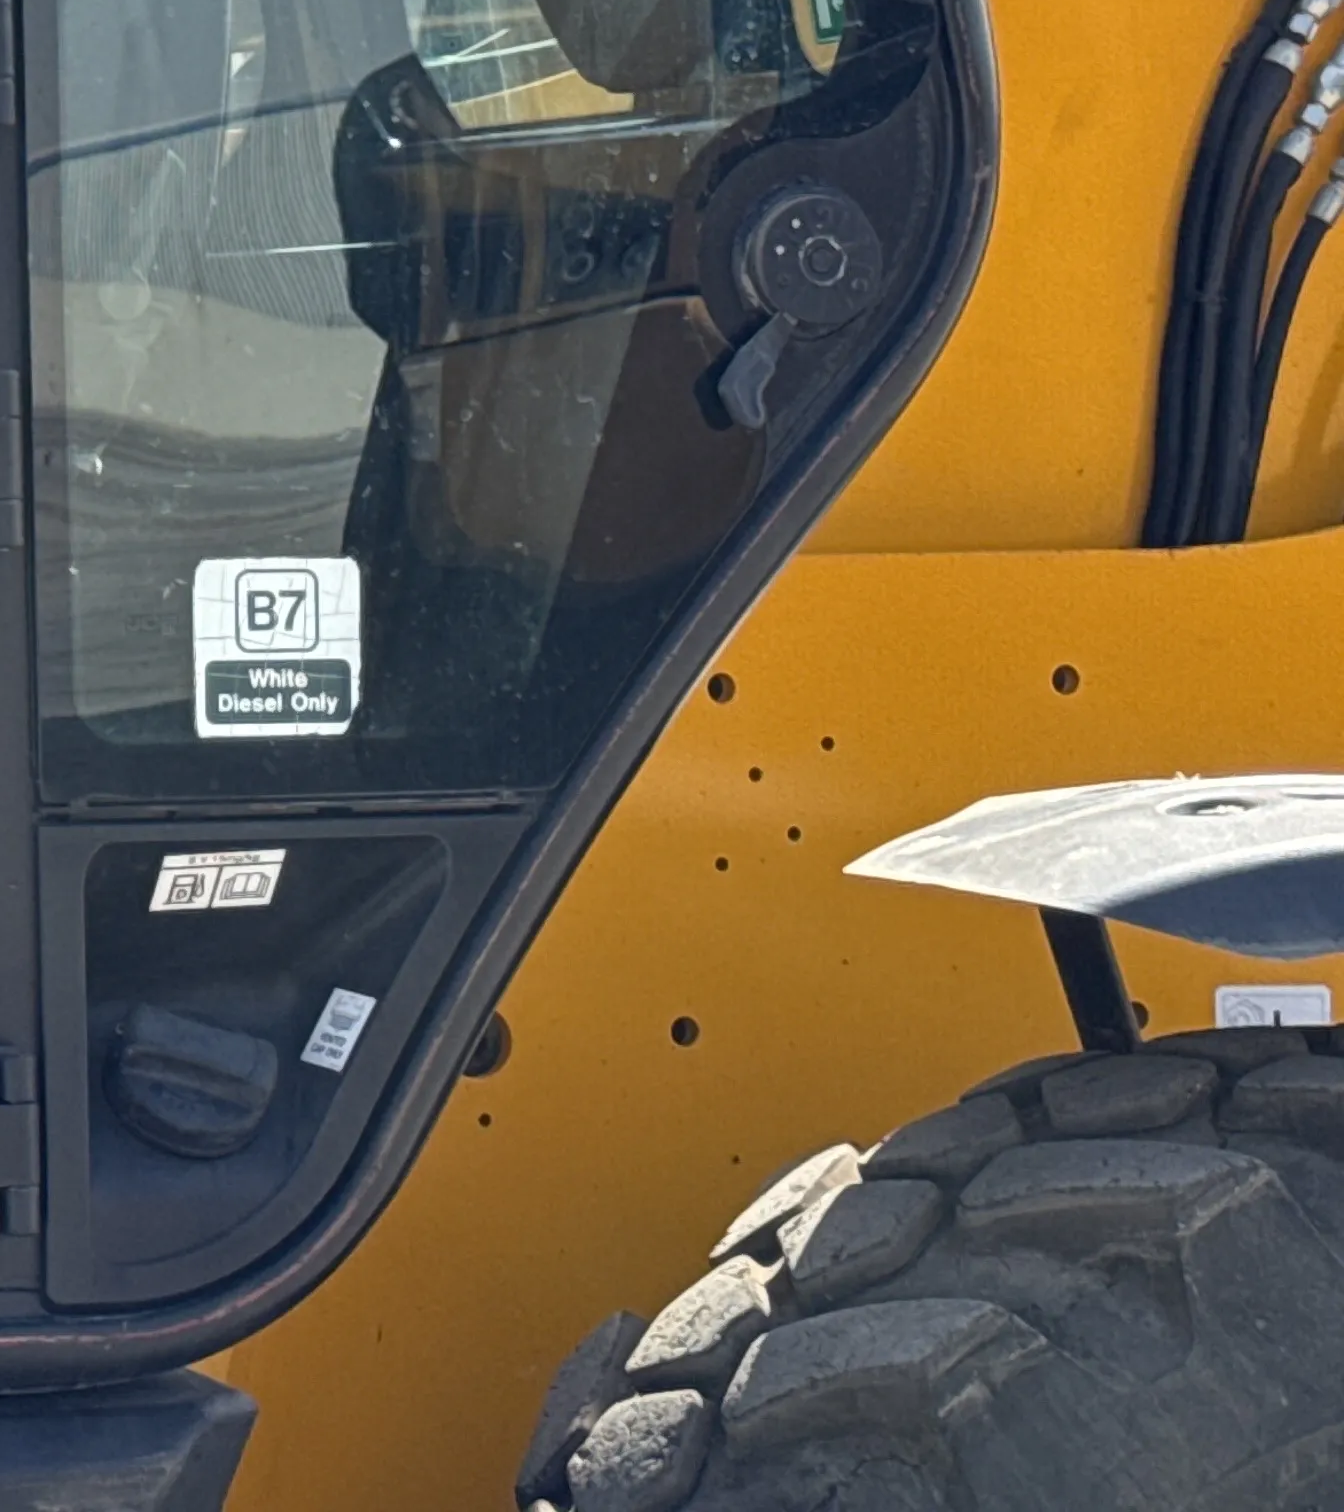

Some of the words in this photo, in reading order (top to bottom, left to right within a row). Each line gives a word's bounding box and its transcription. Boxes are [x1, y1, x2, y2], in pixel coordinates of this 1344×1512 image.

[246, 590, 307, 632] B7
[248, 668, 309, 689] White
[217, 692, 283, 713] Diesel
[290, 691, 340, 715] Only
